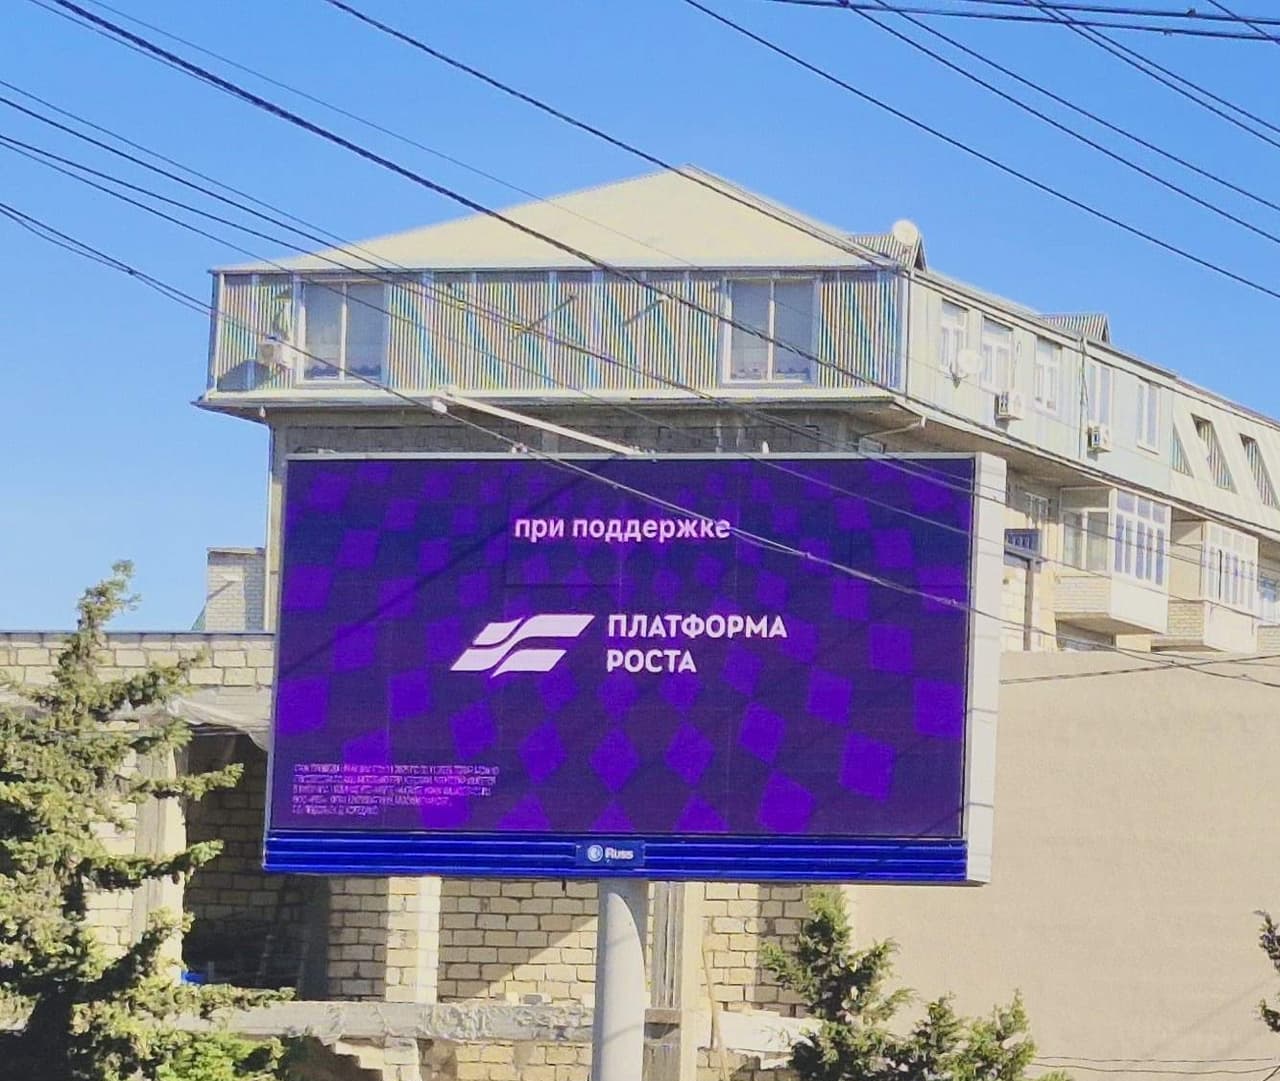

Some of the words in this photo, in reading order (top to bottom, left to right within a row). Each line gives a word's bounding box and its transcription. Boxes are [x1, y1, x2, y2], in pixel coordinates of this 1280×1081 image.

[514, 518, 565, 542] при
[572, 518, 731, 542] поддержке
[607, 613, 788, 639] ПЛАТФОРМА
[606, 649, 697, 673] РОСТА
